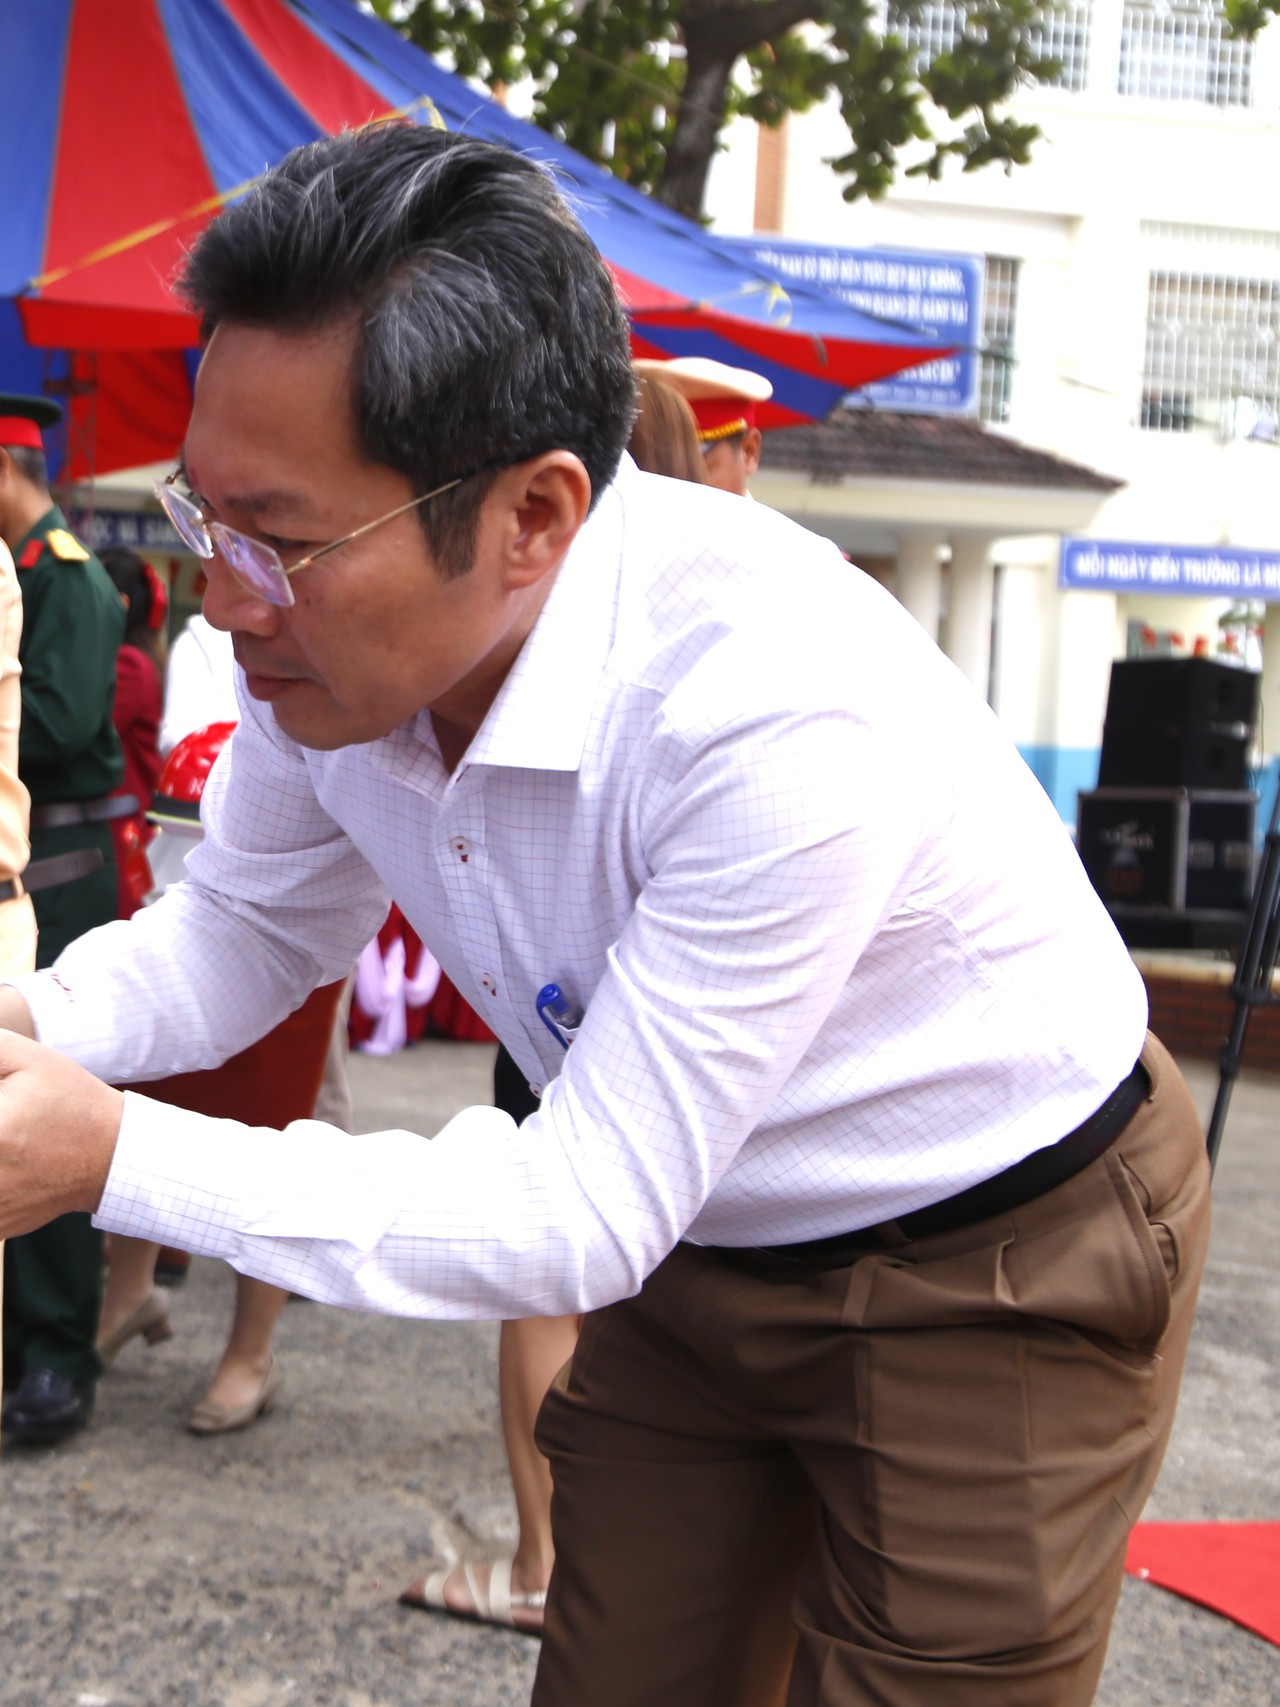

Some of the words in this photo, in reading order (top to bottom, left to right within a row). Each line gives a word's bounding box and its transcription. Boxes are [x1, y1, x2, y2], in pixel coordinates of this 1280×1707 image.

[1108, 548, 1148, 581] NGÀY
[1150, 549, 1180, 583] ĐẾN
[1183, 553, 1241, 586] TRƯỜNG
[1244, 555, 1262, 588] LÀ
